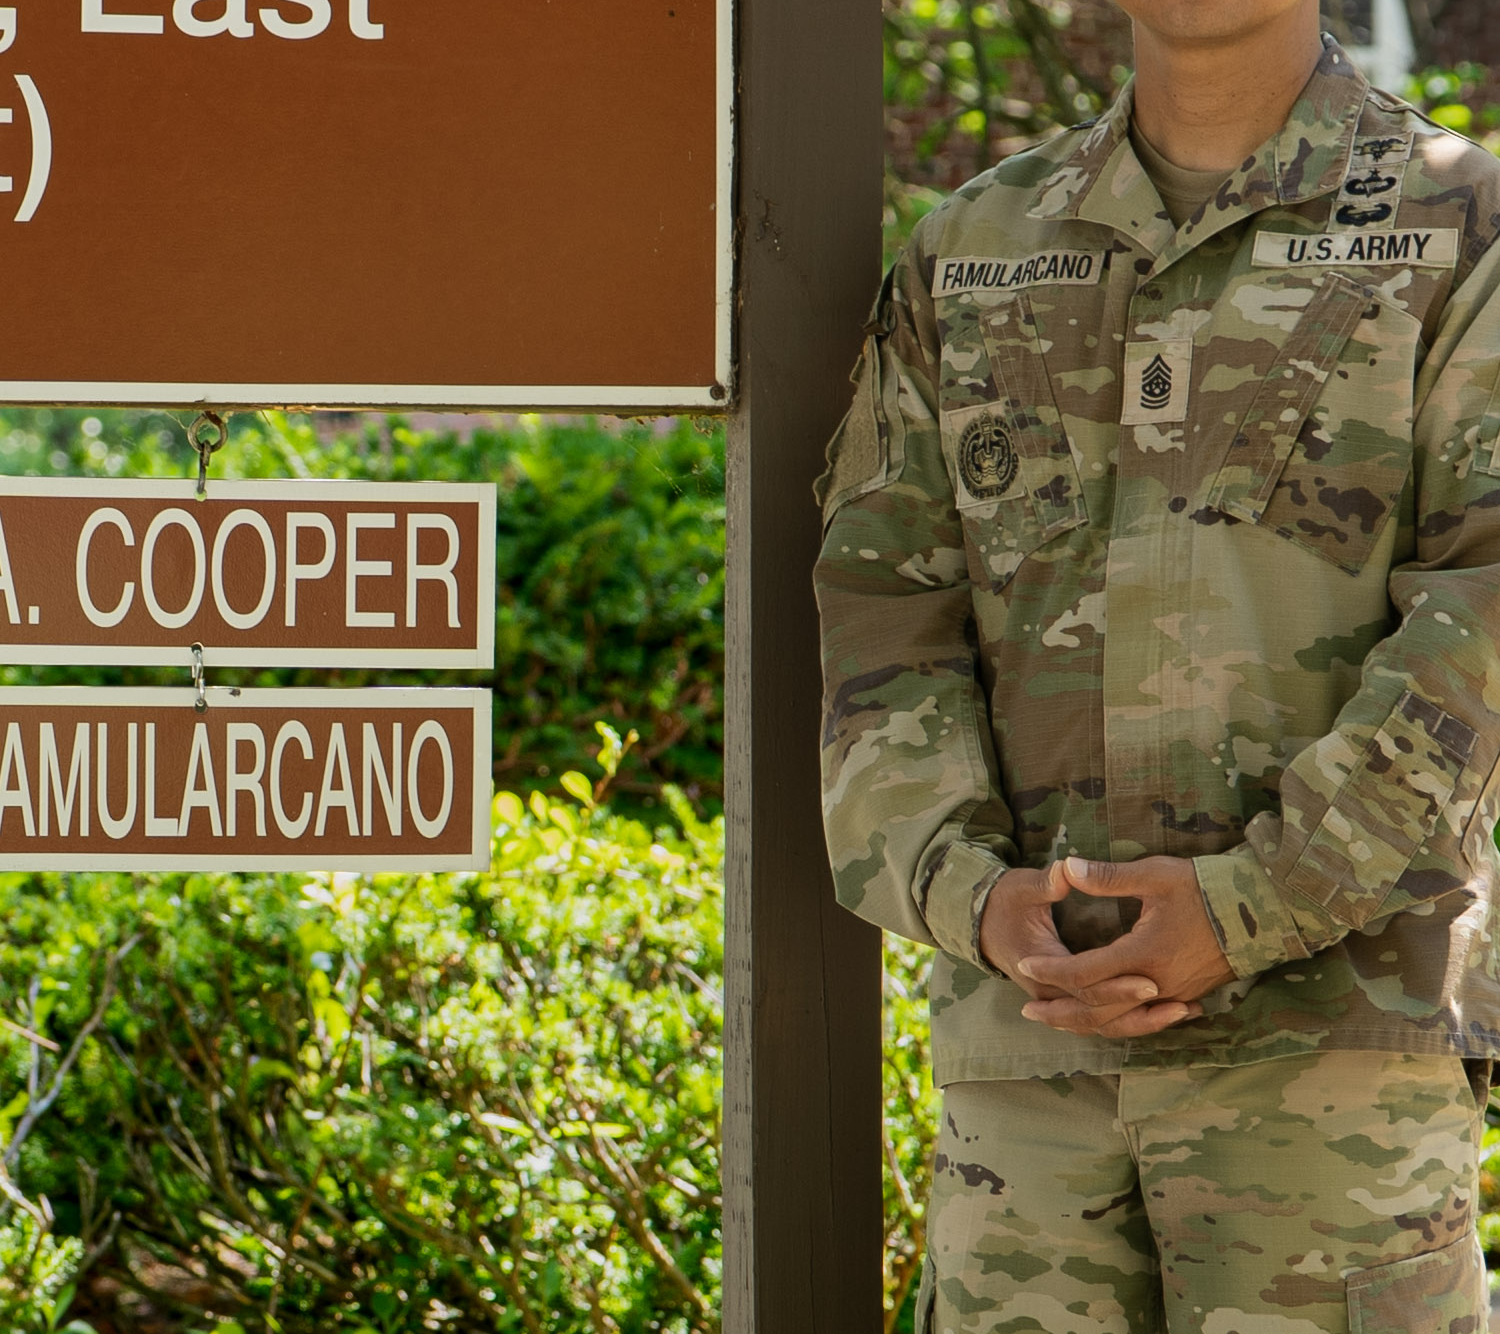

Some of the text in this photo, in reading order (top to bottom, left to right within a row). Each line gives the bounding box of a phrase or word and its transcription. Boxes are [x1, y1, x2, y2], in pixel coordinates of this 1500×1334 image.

[1287, 233, 1432, 262] U.S. ARMY
[942, 255, 1093, 290] FAMULARCANO
[76, 508, 460, 629] COOPER
